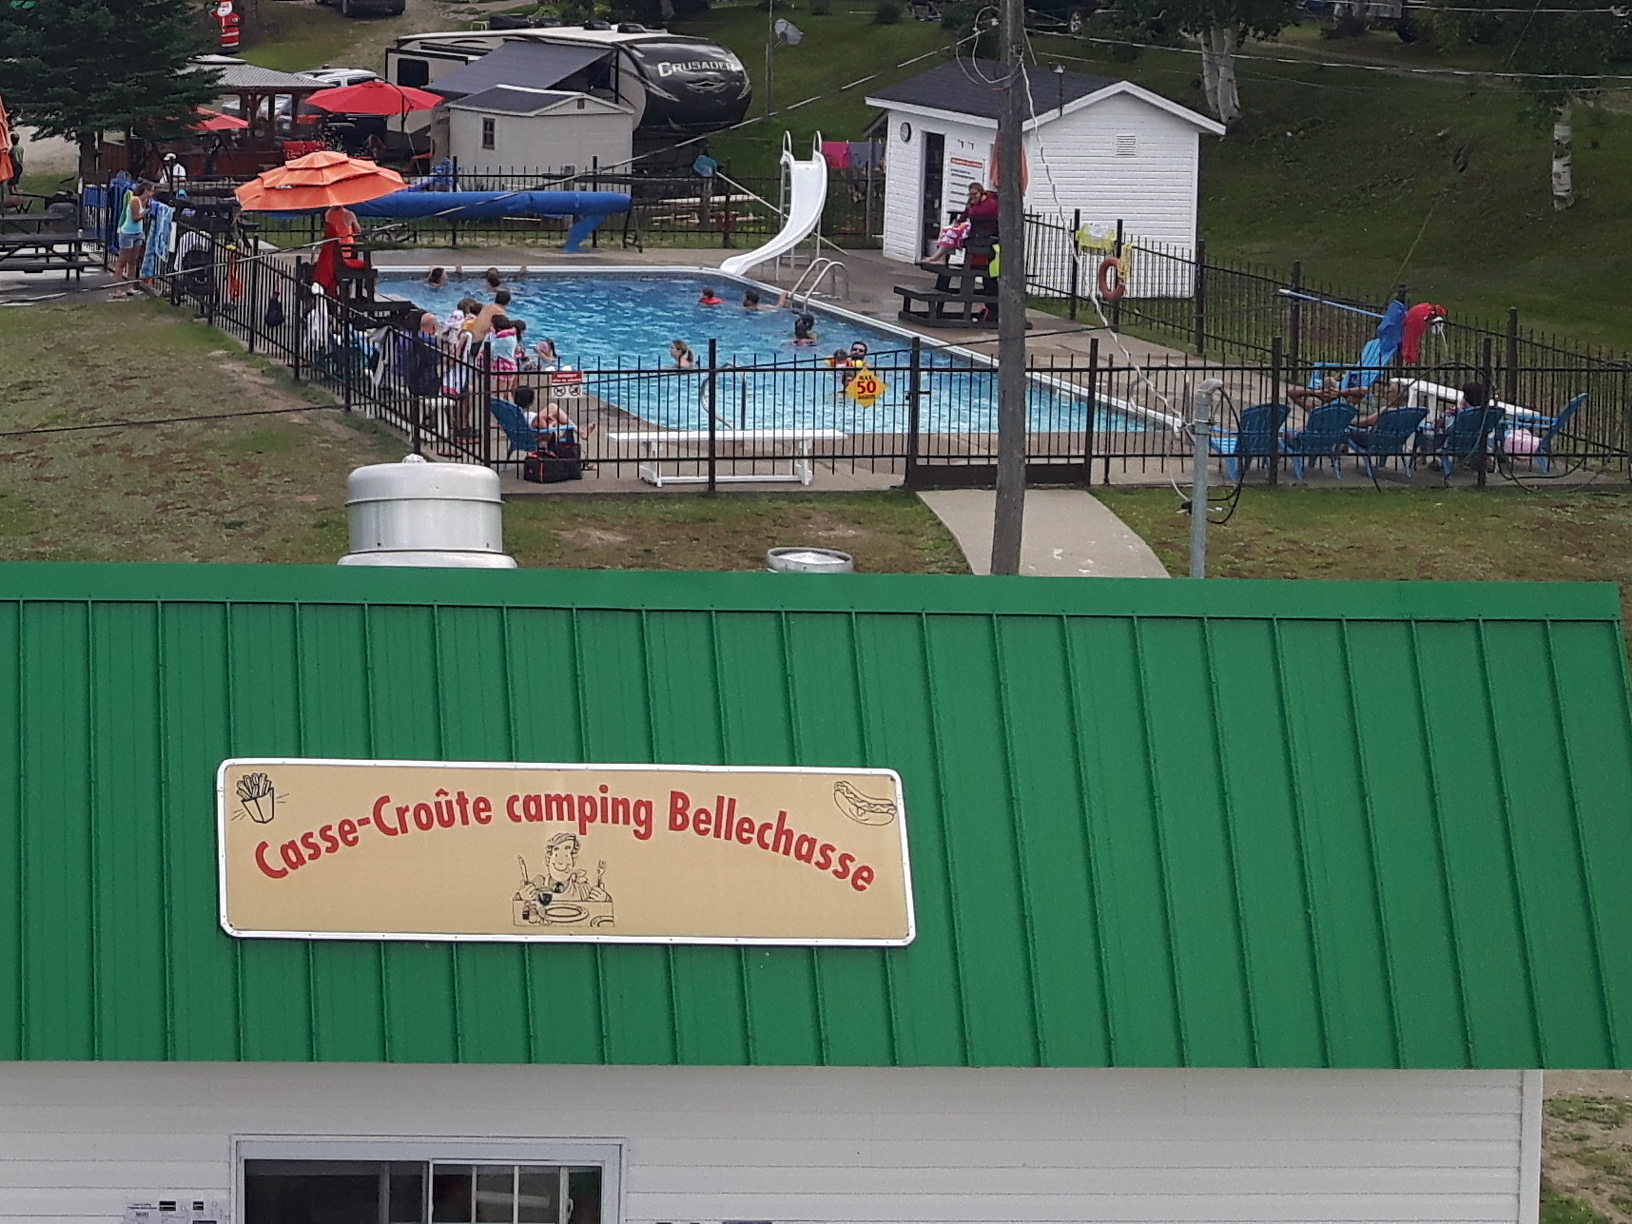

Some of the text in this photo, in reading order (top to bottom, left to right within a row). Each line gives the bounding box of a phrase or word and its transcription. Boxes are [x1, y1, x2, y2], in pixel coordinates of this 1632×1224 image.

[657, 61, 734, 77] CRUSADER
[857, 380, 877, 394] 50
[255, 784, 875, 892] Casse-Croûte camping Bellechasse
